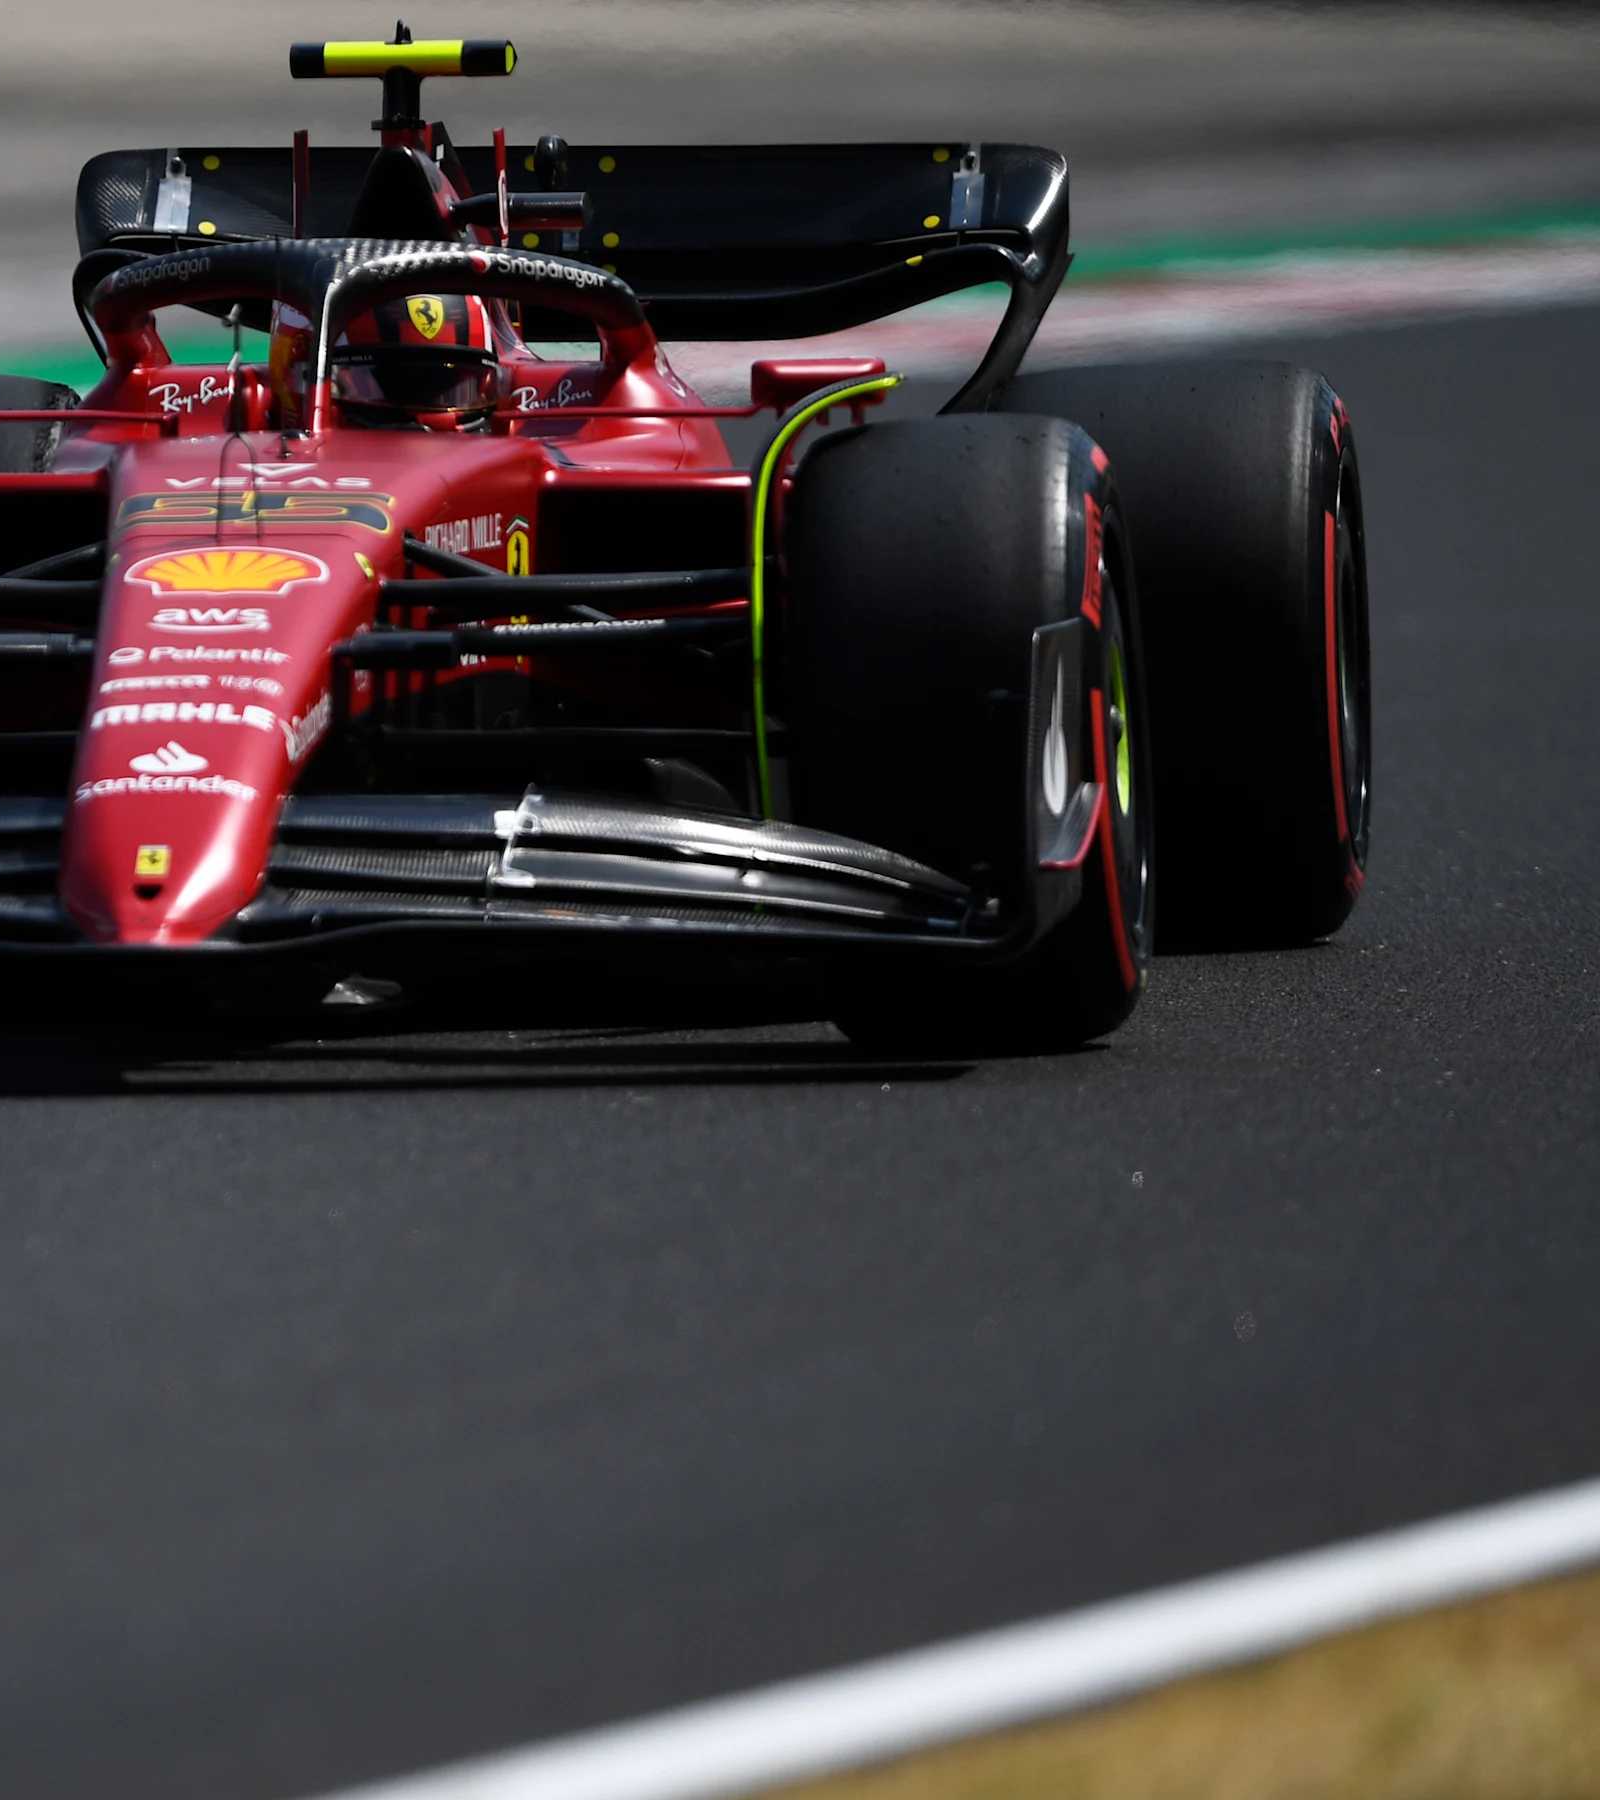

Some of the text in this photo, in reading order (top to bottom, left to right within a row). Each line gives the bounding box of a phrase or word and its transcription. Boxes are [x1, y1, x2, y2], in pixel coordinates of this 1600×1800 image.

[118, 255, 212, 288] Snapdragon
[497, 252, 607, 288] Snapdragon
[149, 376, 236, 414] Ray-Ban
[511, 378, 593, 412] Ray-Ban
[164, 476, 372, 489] VELAS
[113, 488, 396, 535] 55
[425, 512, 503, 554] RICHARD MILLE
[152, 607, 269, 624] aws
[493, 618, 666, 635] #WeRaceAsOne
[148, 645, 292, 665] Palantir
[91, 701, 277, 732] MAHLE
[74, 773, 260, 803] Santander
